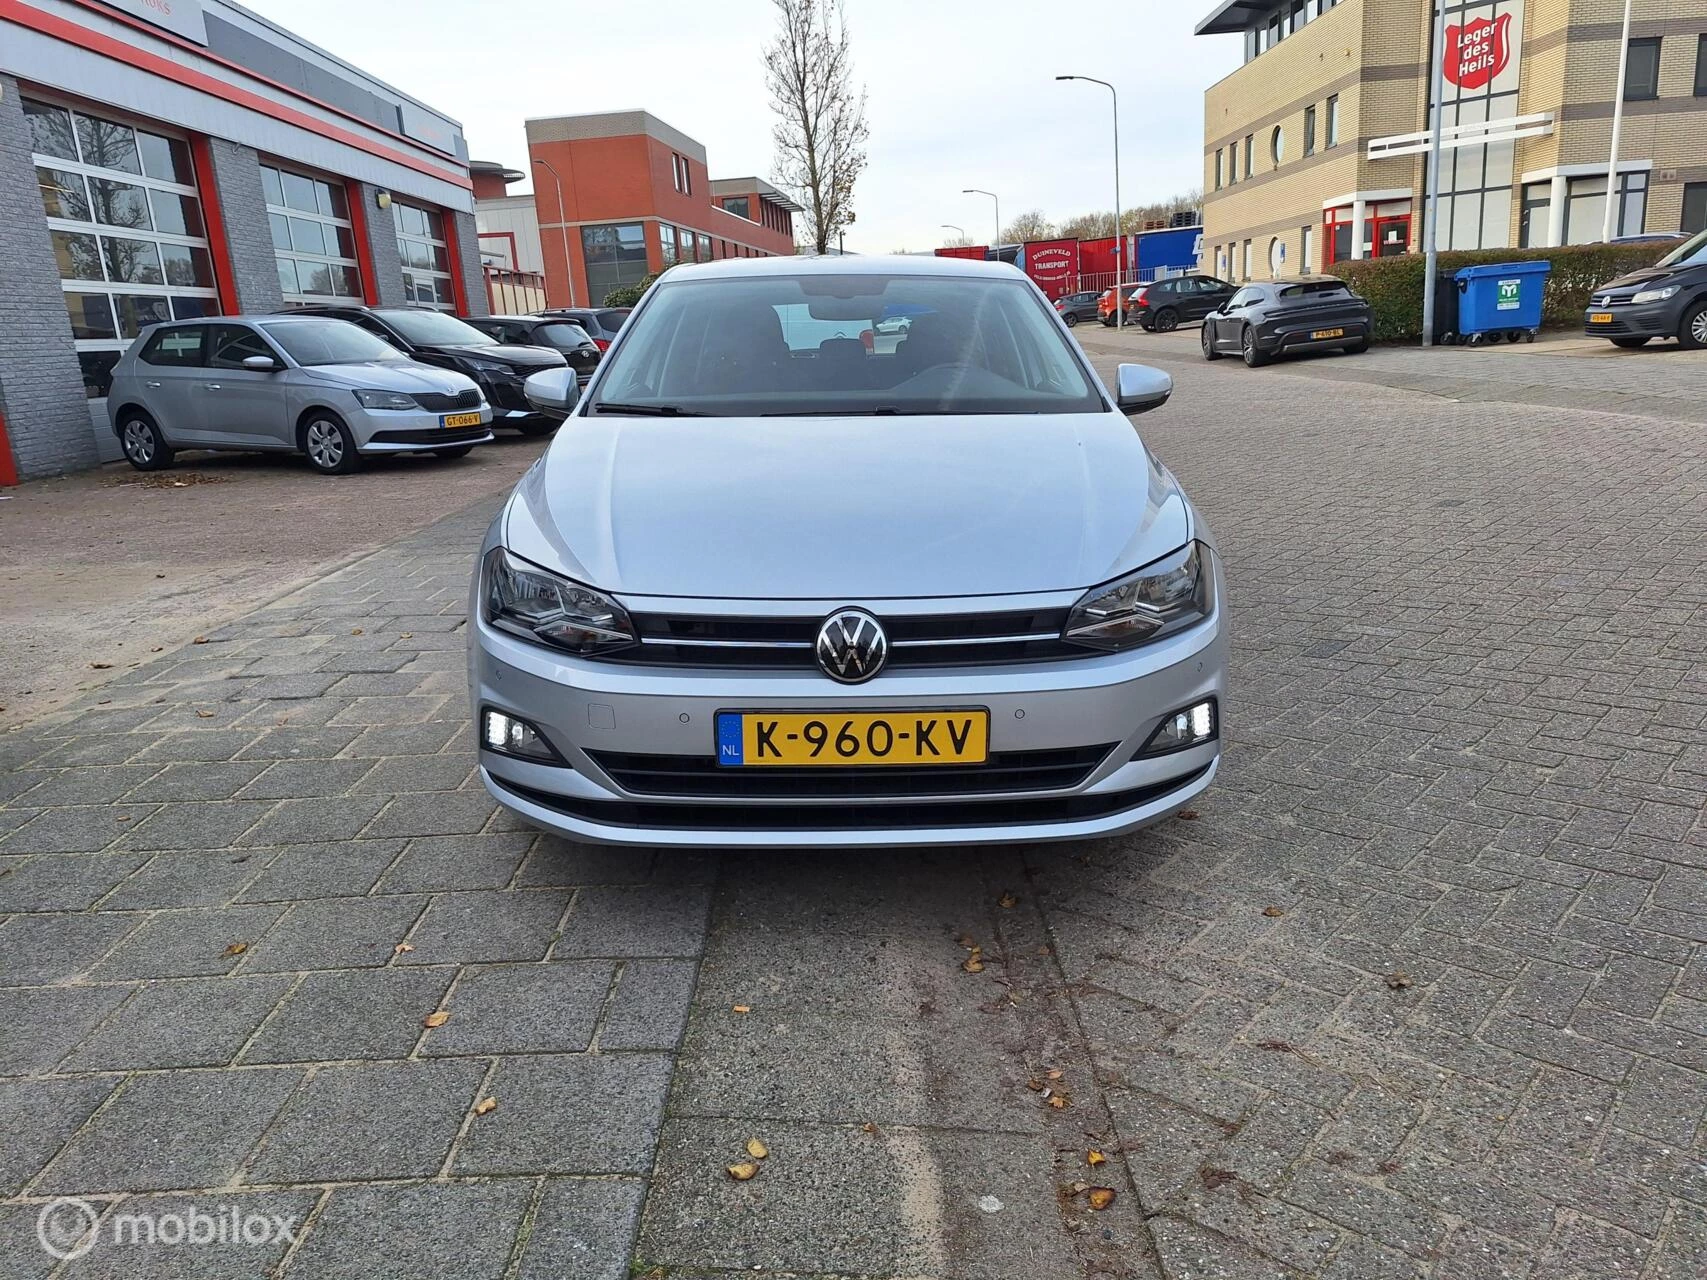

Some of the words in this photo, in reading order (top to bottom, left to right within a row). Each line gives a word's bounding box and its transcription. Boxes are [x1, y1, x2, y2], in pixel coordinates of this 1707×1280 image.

[1457, 22, 1498, 48] Leger
[1463, 41, 1489, 60] des
[1459, 54, 1495, 77] Heils
[1032, 248, 1071, 261] DUINEVELD
[1034, 260, 1069, 270] TRANSPORT
[722, 744, 739, 756] NL
[756, 719, 972, 758] K-960-KV
